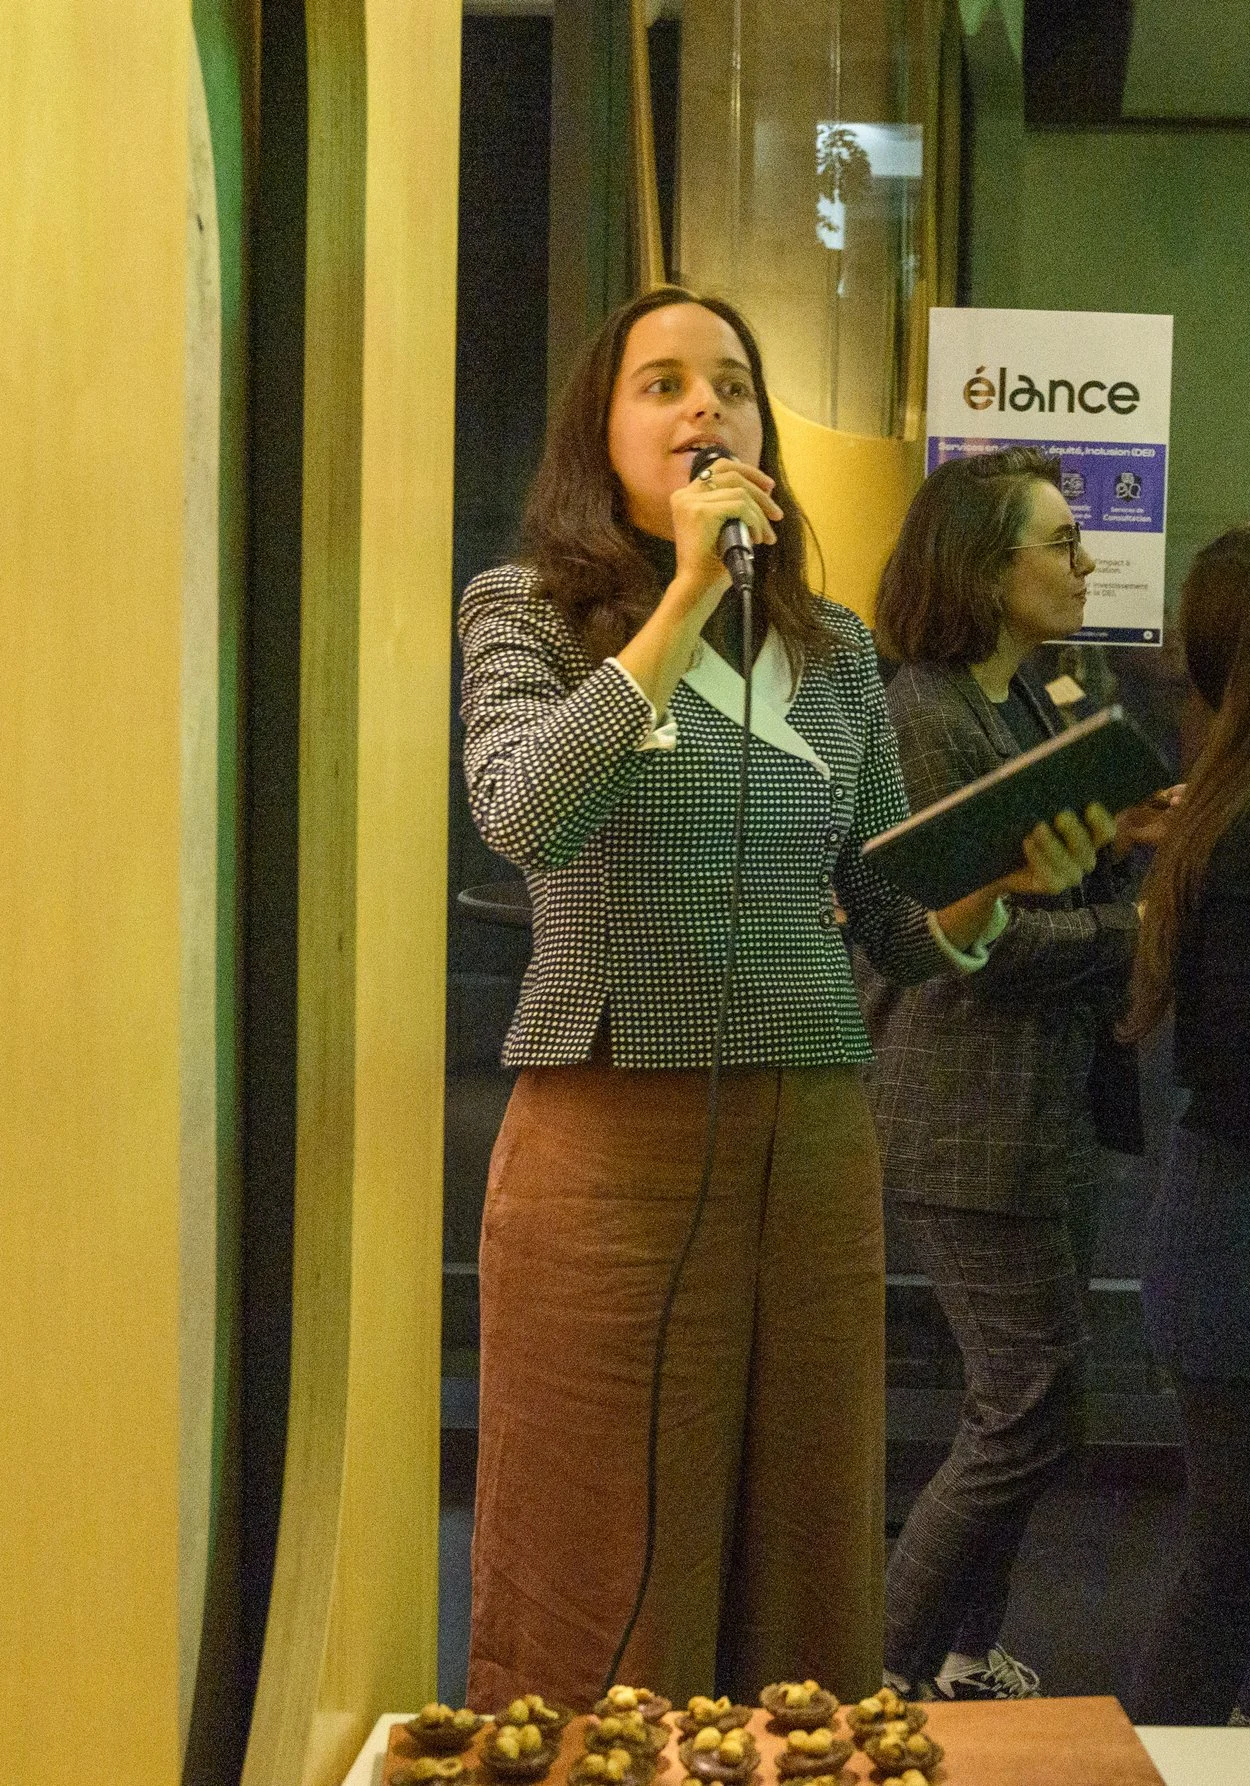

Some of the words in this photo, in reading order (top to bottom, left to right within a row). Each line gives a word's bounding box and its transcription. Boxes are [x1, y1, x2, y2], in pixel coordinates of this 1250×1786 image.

[963, 365, 1140, 415] élance
[1049, 445, 1084, 456] équité,
[1085, 446, 1130, 457] inclusion
[1131, 447, 1155, 457] (DEI)
[1103, 514, 1152, 523] Consultation
